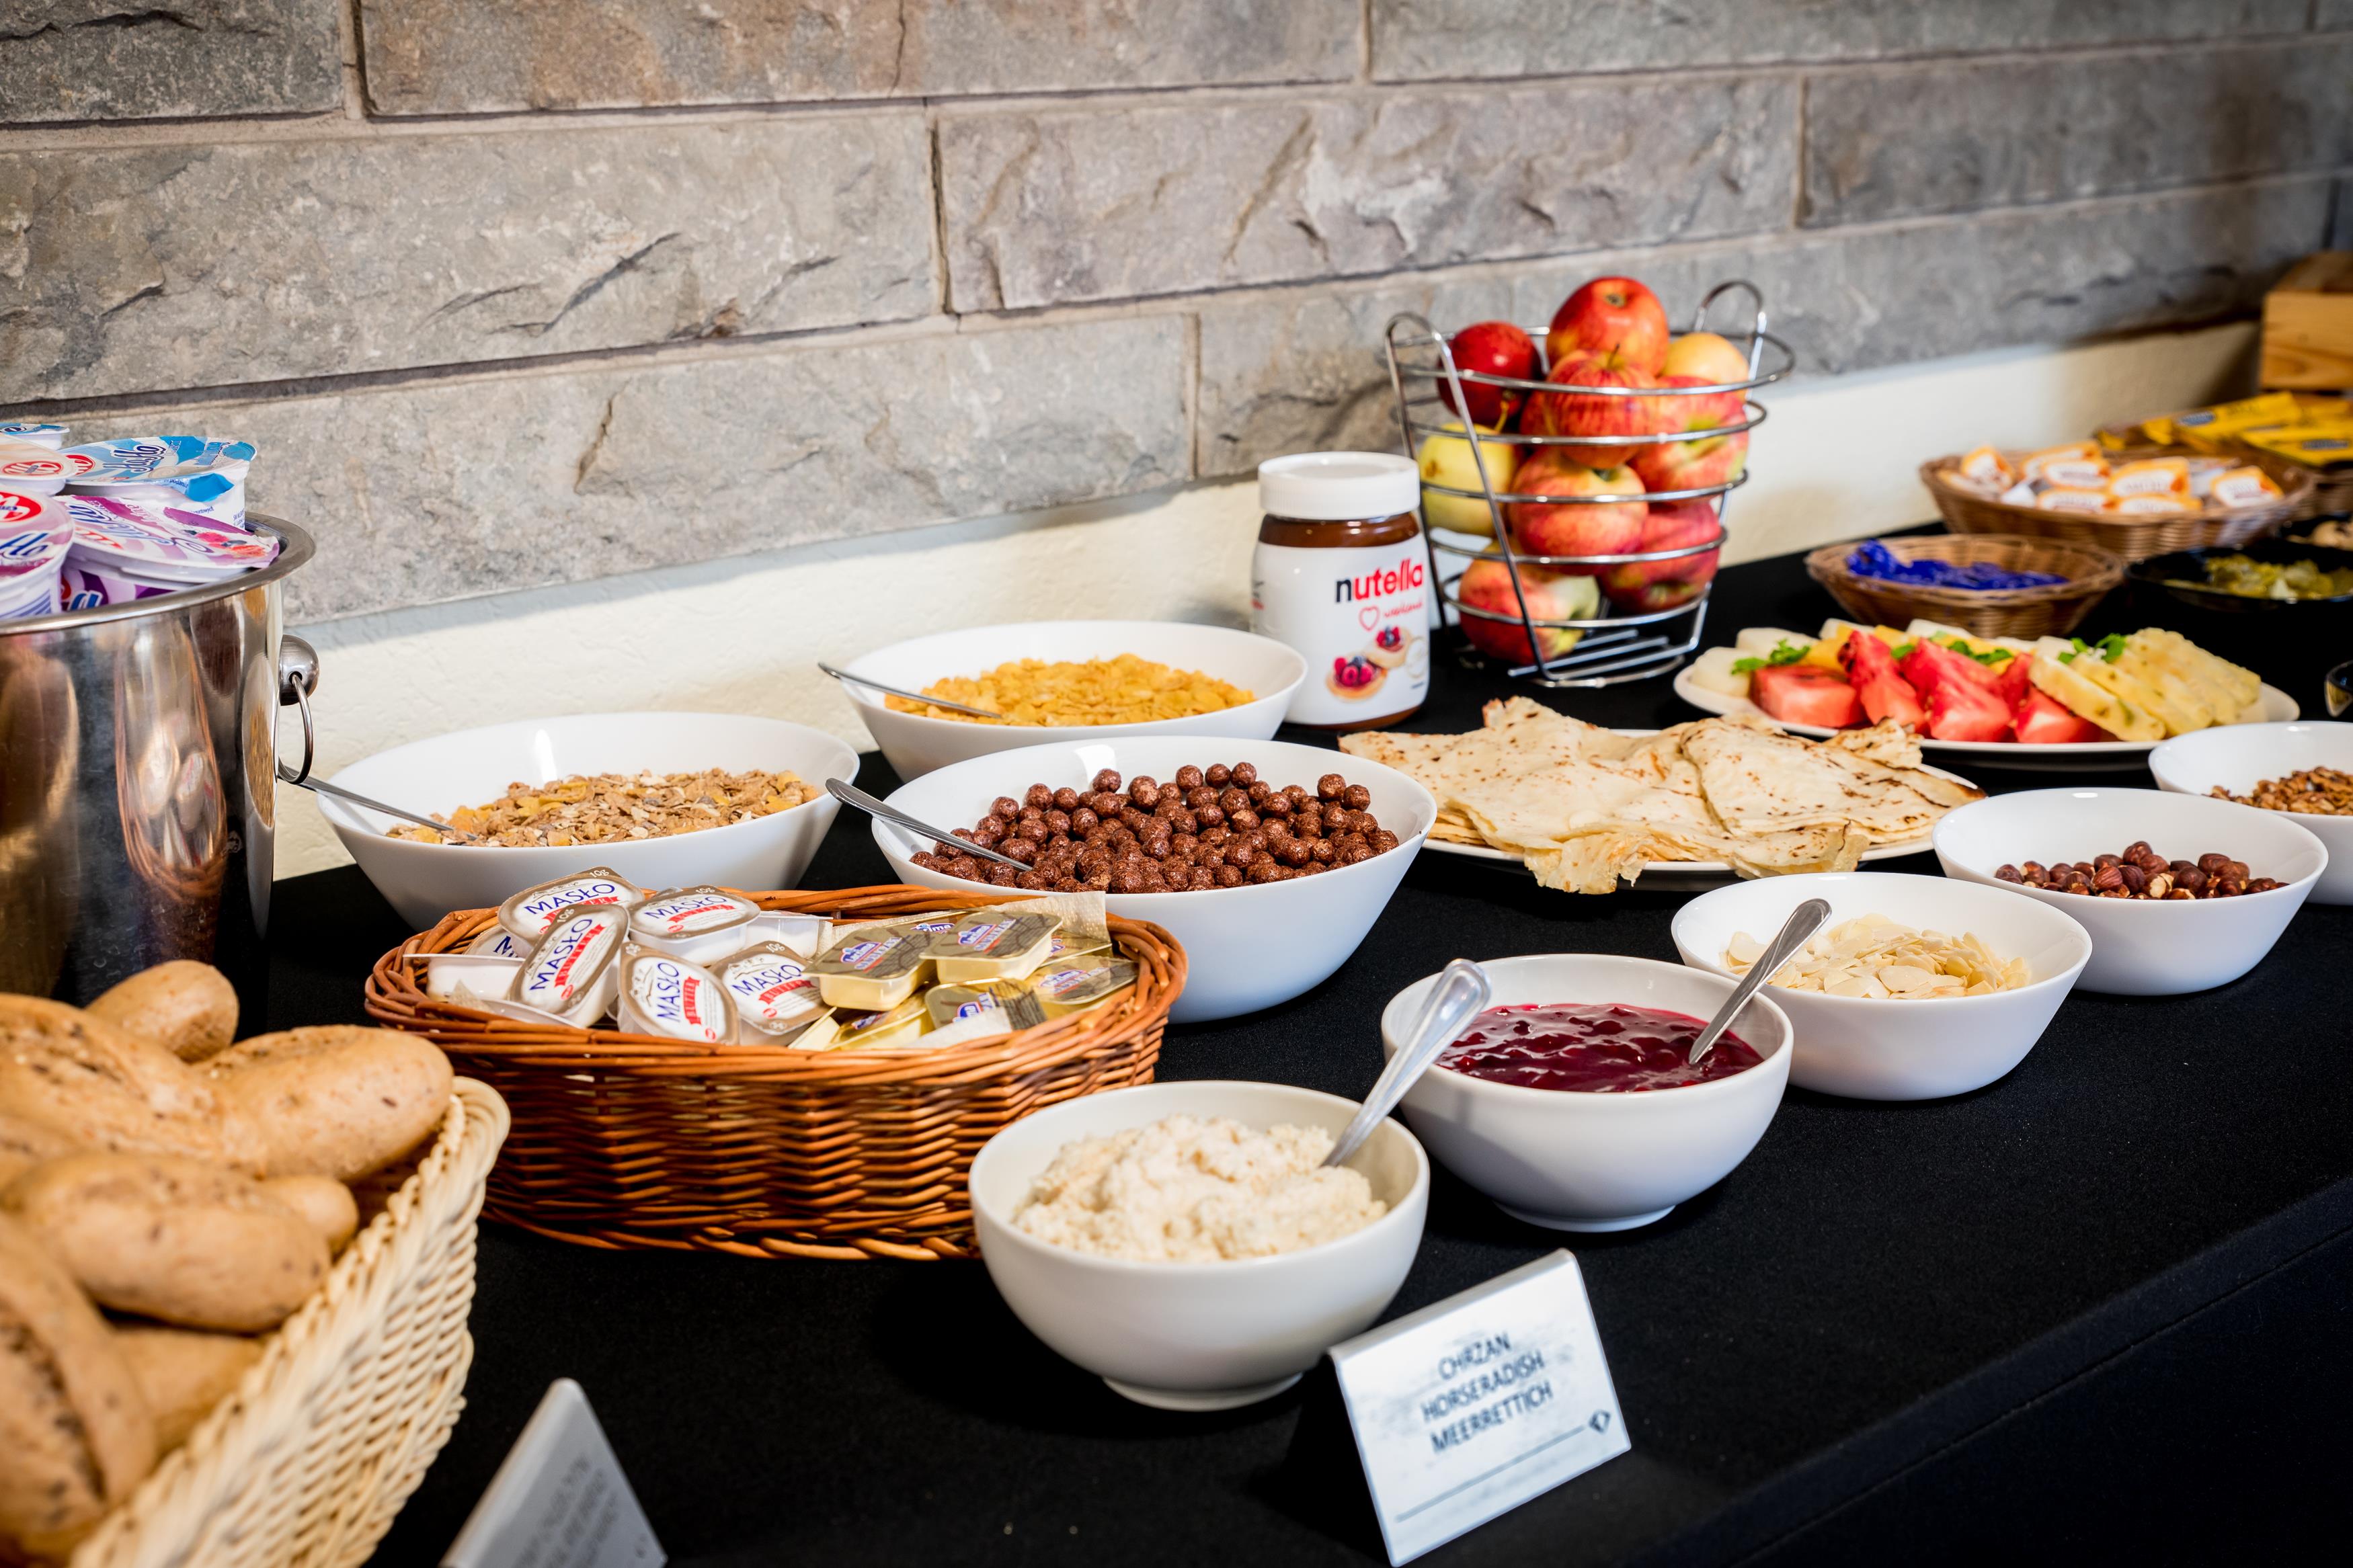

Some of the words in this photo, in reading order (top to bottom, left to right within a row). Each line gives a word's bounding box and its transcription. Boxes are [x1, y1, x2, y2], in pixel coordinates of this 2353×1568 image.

[1336, 559, 1423, 603] nutella
[590, 869, 609, 878] 10g
[524, 884, 615, 915] MASŁO
[643, 896, 727, 919] MASŁO
[528, 919, 592, 990] MASŁO
[656, 962, 680, 1022] MASŁO
[731, 964, 801, 996] MASŁO
[1439, 1333, 1511, 1379] CHRZAN
[1421, 1350, 1545, 1421] HORSERADISH
[1431, 1380, 1553, 1452] MEERRETTICH
